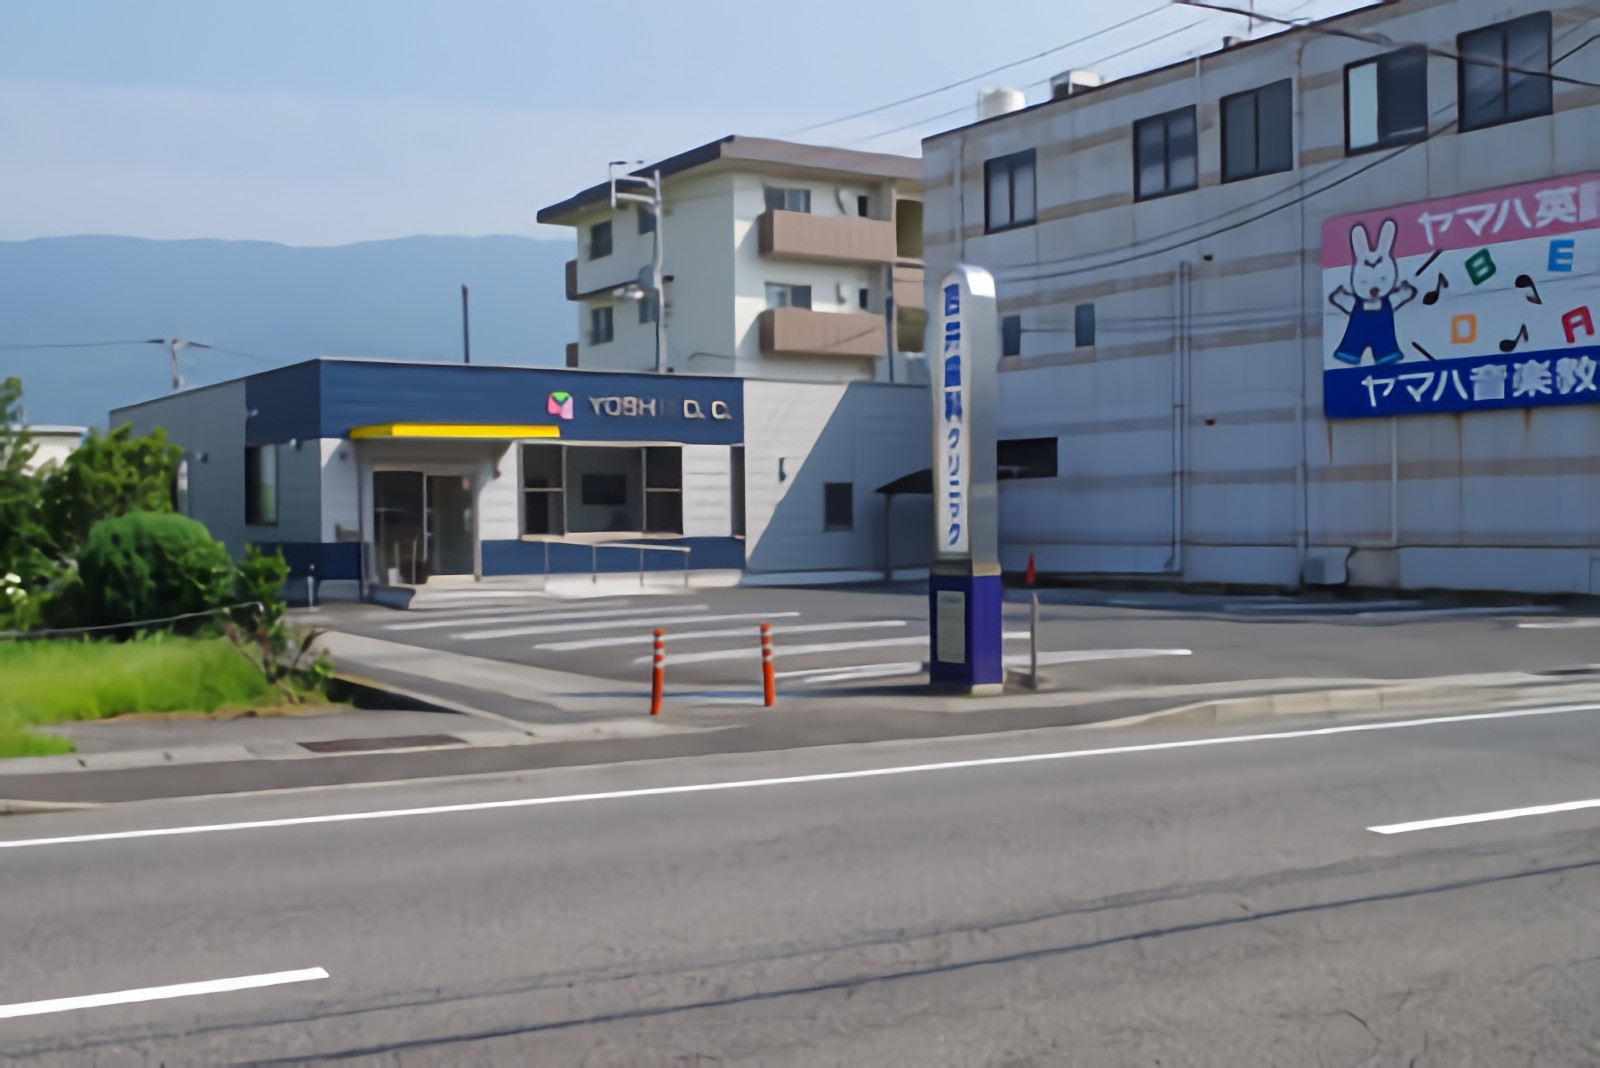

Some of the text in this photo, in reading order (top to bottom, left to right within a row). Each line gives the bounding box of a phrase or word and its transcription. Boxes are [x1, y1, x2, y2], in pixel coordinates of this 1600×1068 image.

[1464, 248, 1497, 286] B
[1548, 239, 1575, 273] E
[1561, 305, 1595, 344] A
